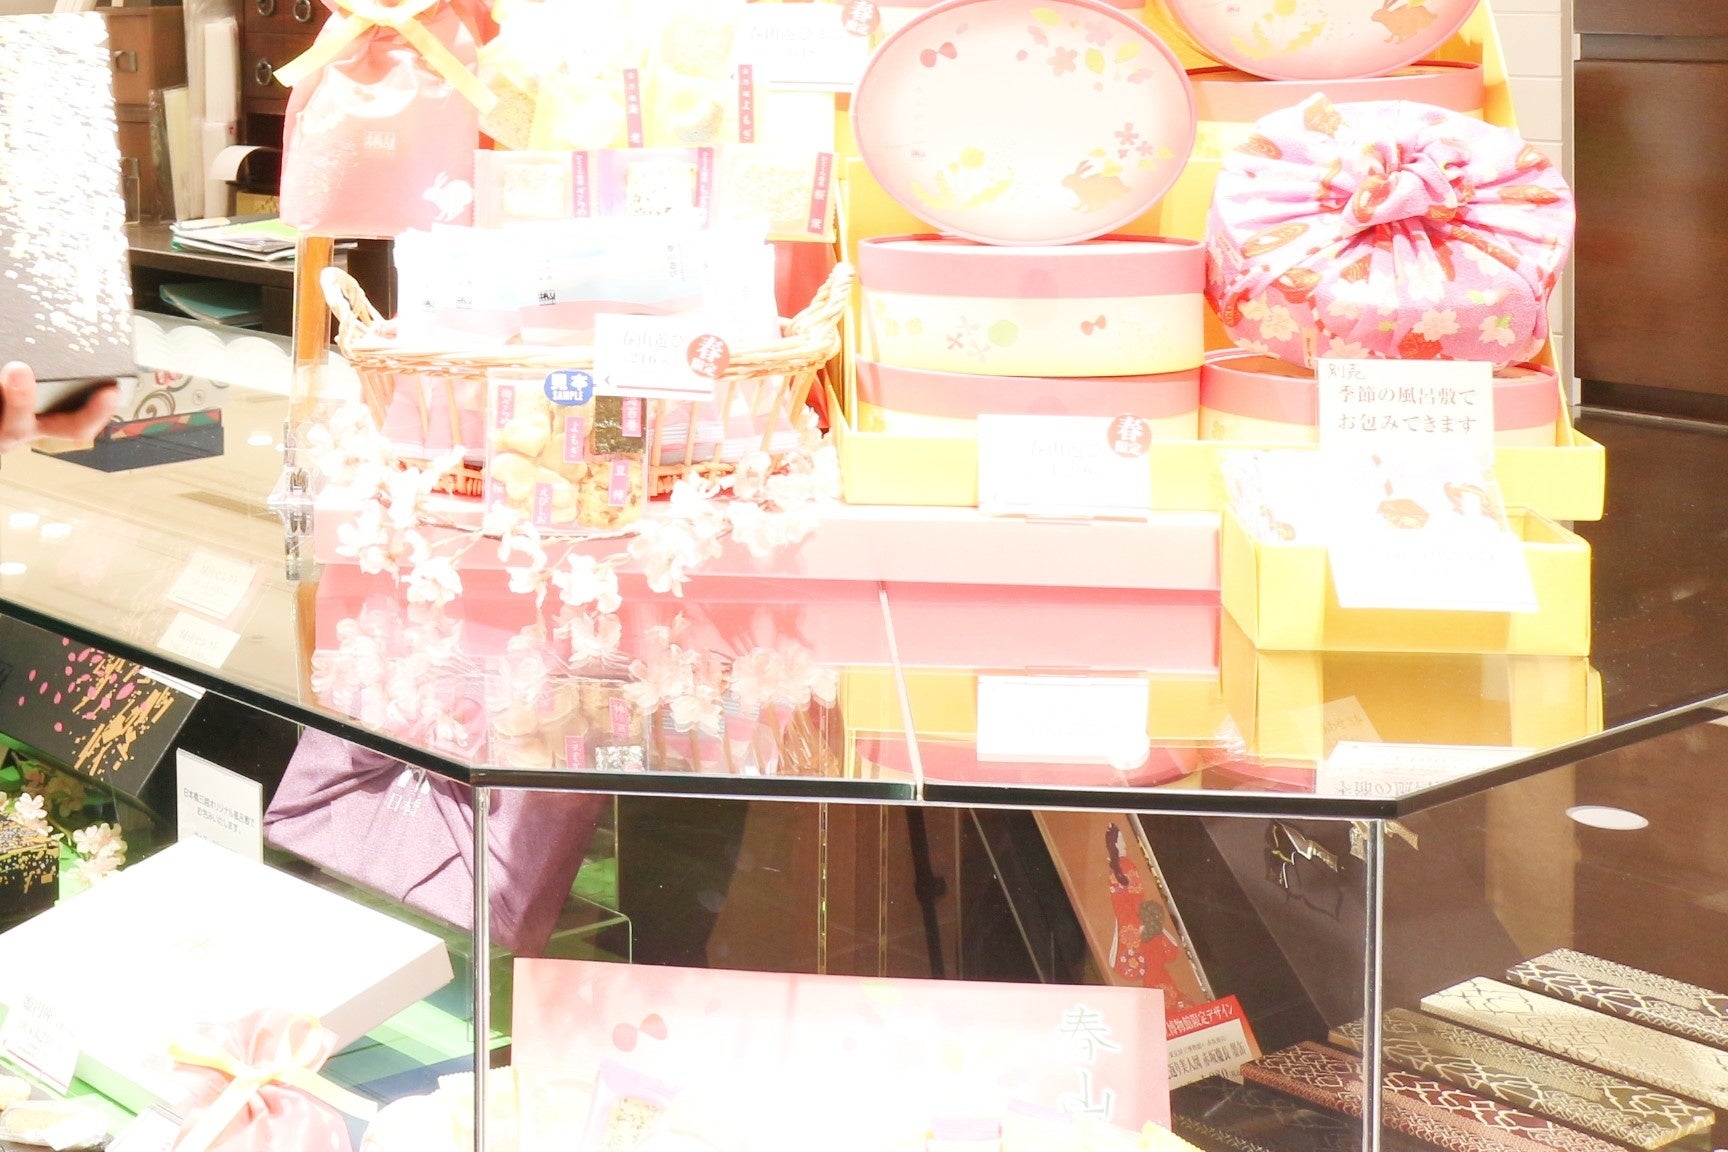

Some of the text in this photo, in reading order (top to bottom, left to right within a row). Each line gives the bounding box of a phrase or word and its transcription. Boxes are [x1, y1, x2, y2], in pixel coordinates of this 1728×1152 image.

[696, 336, 723, 362] 春
[551, 373, 589, 392] 見本
[552, 390, 584, 401] SAMPLE
[1119, 416, 1144, 440] 春
[1338, 413, 1477, 434] お包みできます
